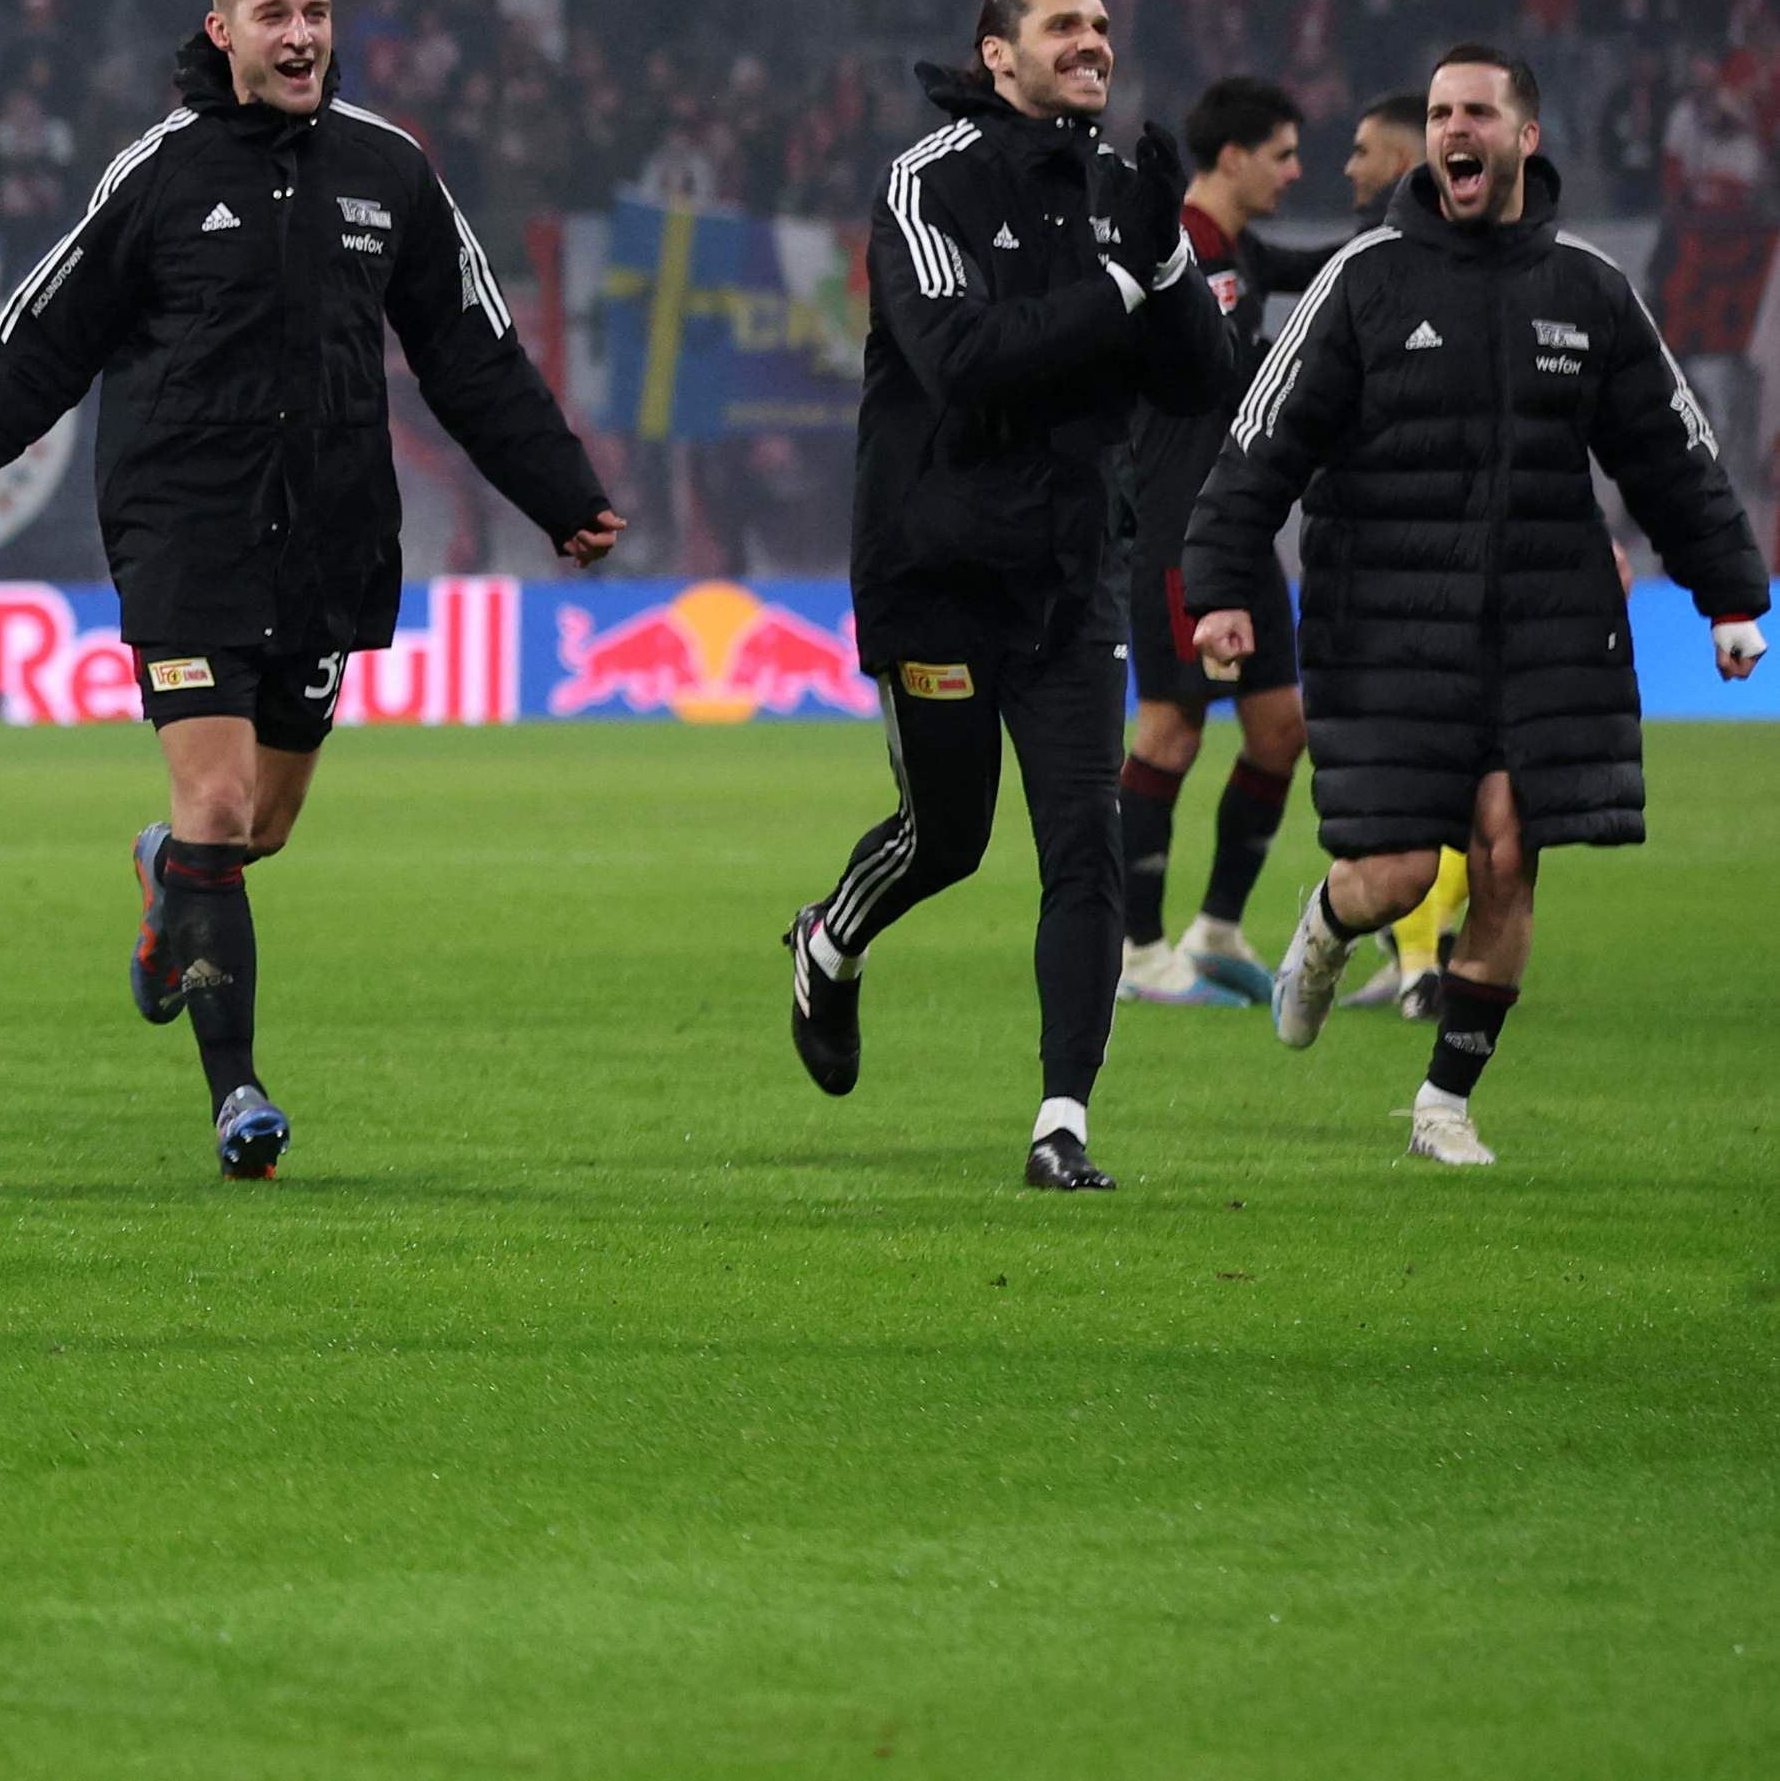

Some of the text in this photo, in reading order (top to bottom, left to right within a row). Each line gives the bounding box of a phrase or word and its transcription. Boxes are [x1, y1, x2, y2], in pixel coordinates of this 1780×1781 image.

[342, 233, 383, 255] wefox
[1535, 354, 1582, 375] wefox
[354, 588, 511, 723] ull
